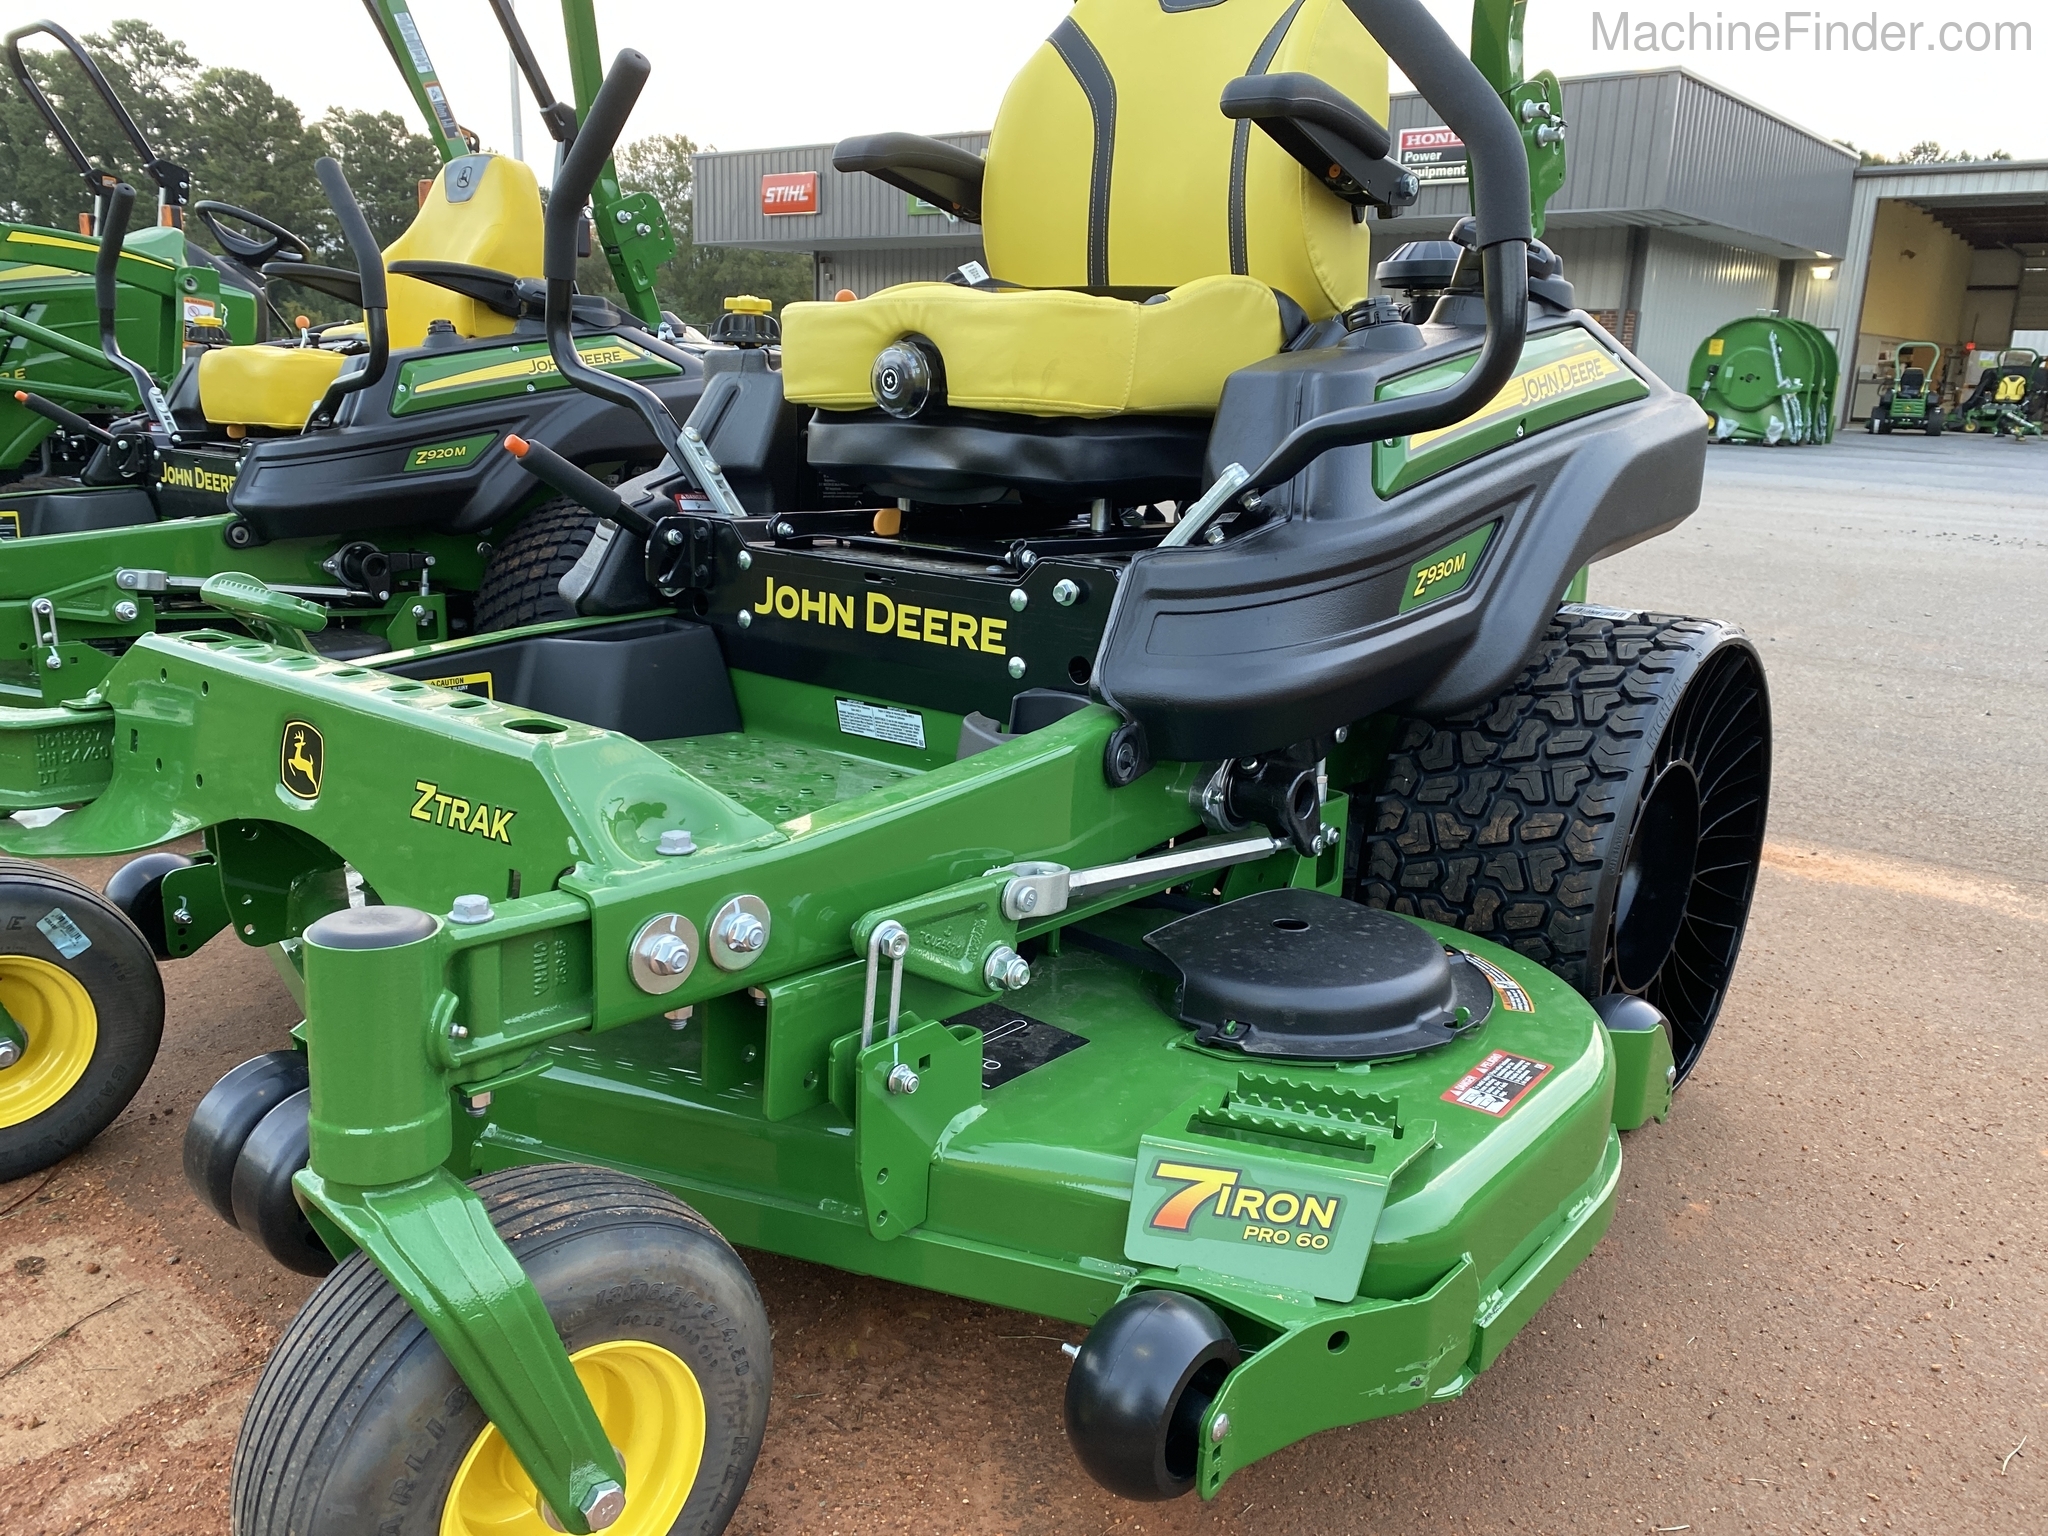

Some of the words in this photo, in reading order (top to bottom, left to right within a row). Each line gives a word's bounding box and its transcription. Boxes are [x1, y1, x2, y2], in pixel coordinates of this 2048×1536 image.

[1405, 132, 1463, 147] HON
[1404, 151, 1442, 162] Power
[1407, 165, 1467, 179] quipment
[764, 184, 809, 203] STIHL
[528, 359, 557, 374] JOH
[1521, 370, 1560, 402] JOHN
[1558, 358, 1605, 389] DEERE
[415, 446, 467, 466] Z920M
[160, 461, 194, 488] JOHN
[1412, 551, 1468, 598] Z930M
[754, 576, 855, 630] JOHN
[866, 591, 1008, 656] DEERE
[436, 677, 465, 687] CAUTION
[410, 780, 517, 845] ZTRAK
[1242, 1225, 1291, 1245] PRO
[1295, 1232, 1330, 1250] 60
